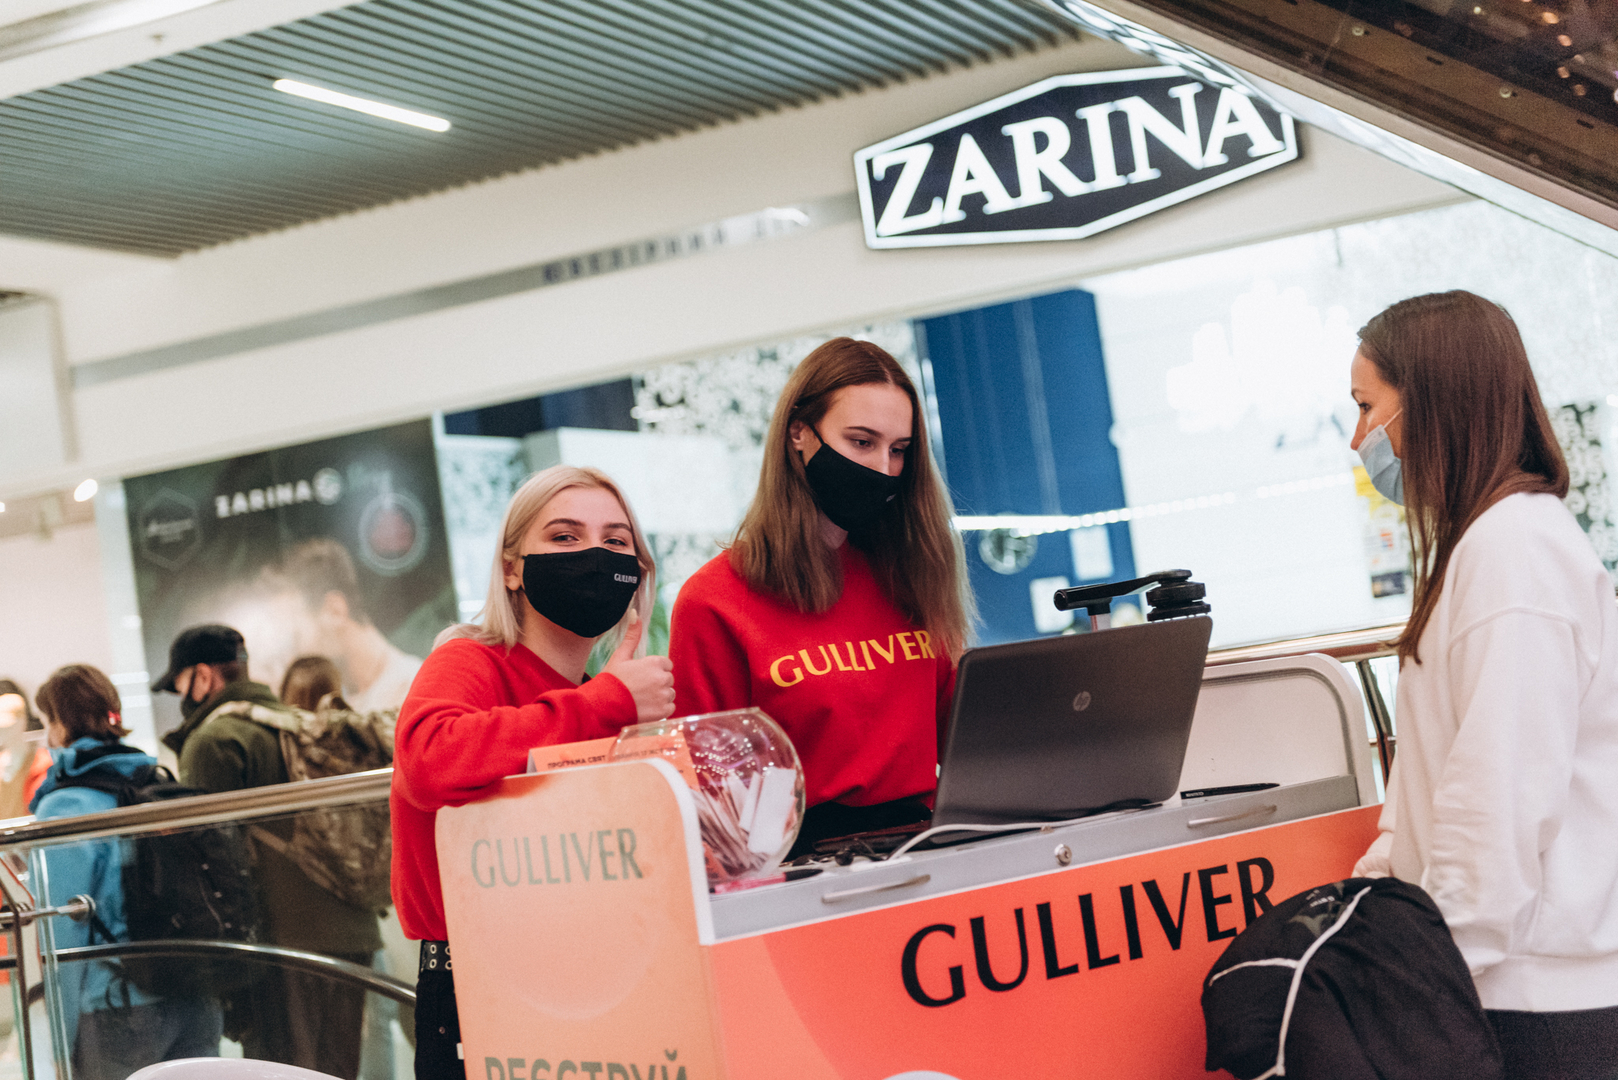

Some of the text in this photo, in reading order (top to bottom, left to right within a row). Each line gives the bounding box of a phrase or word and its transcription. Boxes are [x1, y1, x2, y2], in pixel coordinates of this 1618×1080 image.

[872, 82, 1286, 237] ZARINA
[769, 630, 936, 688] GULLIVER
[471, 828, 643, 888] GULLIVER
[901, 857, 1275, 1008] GULLIVER
